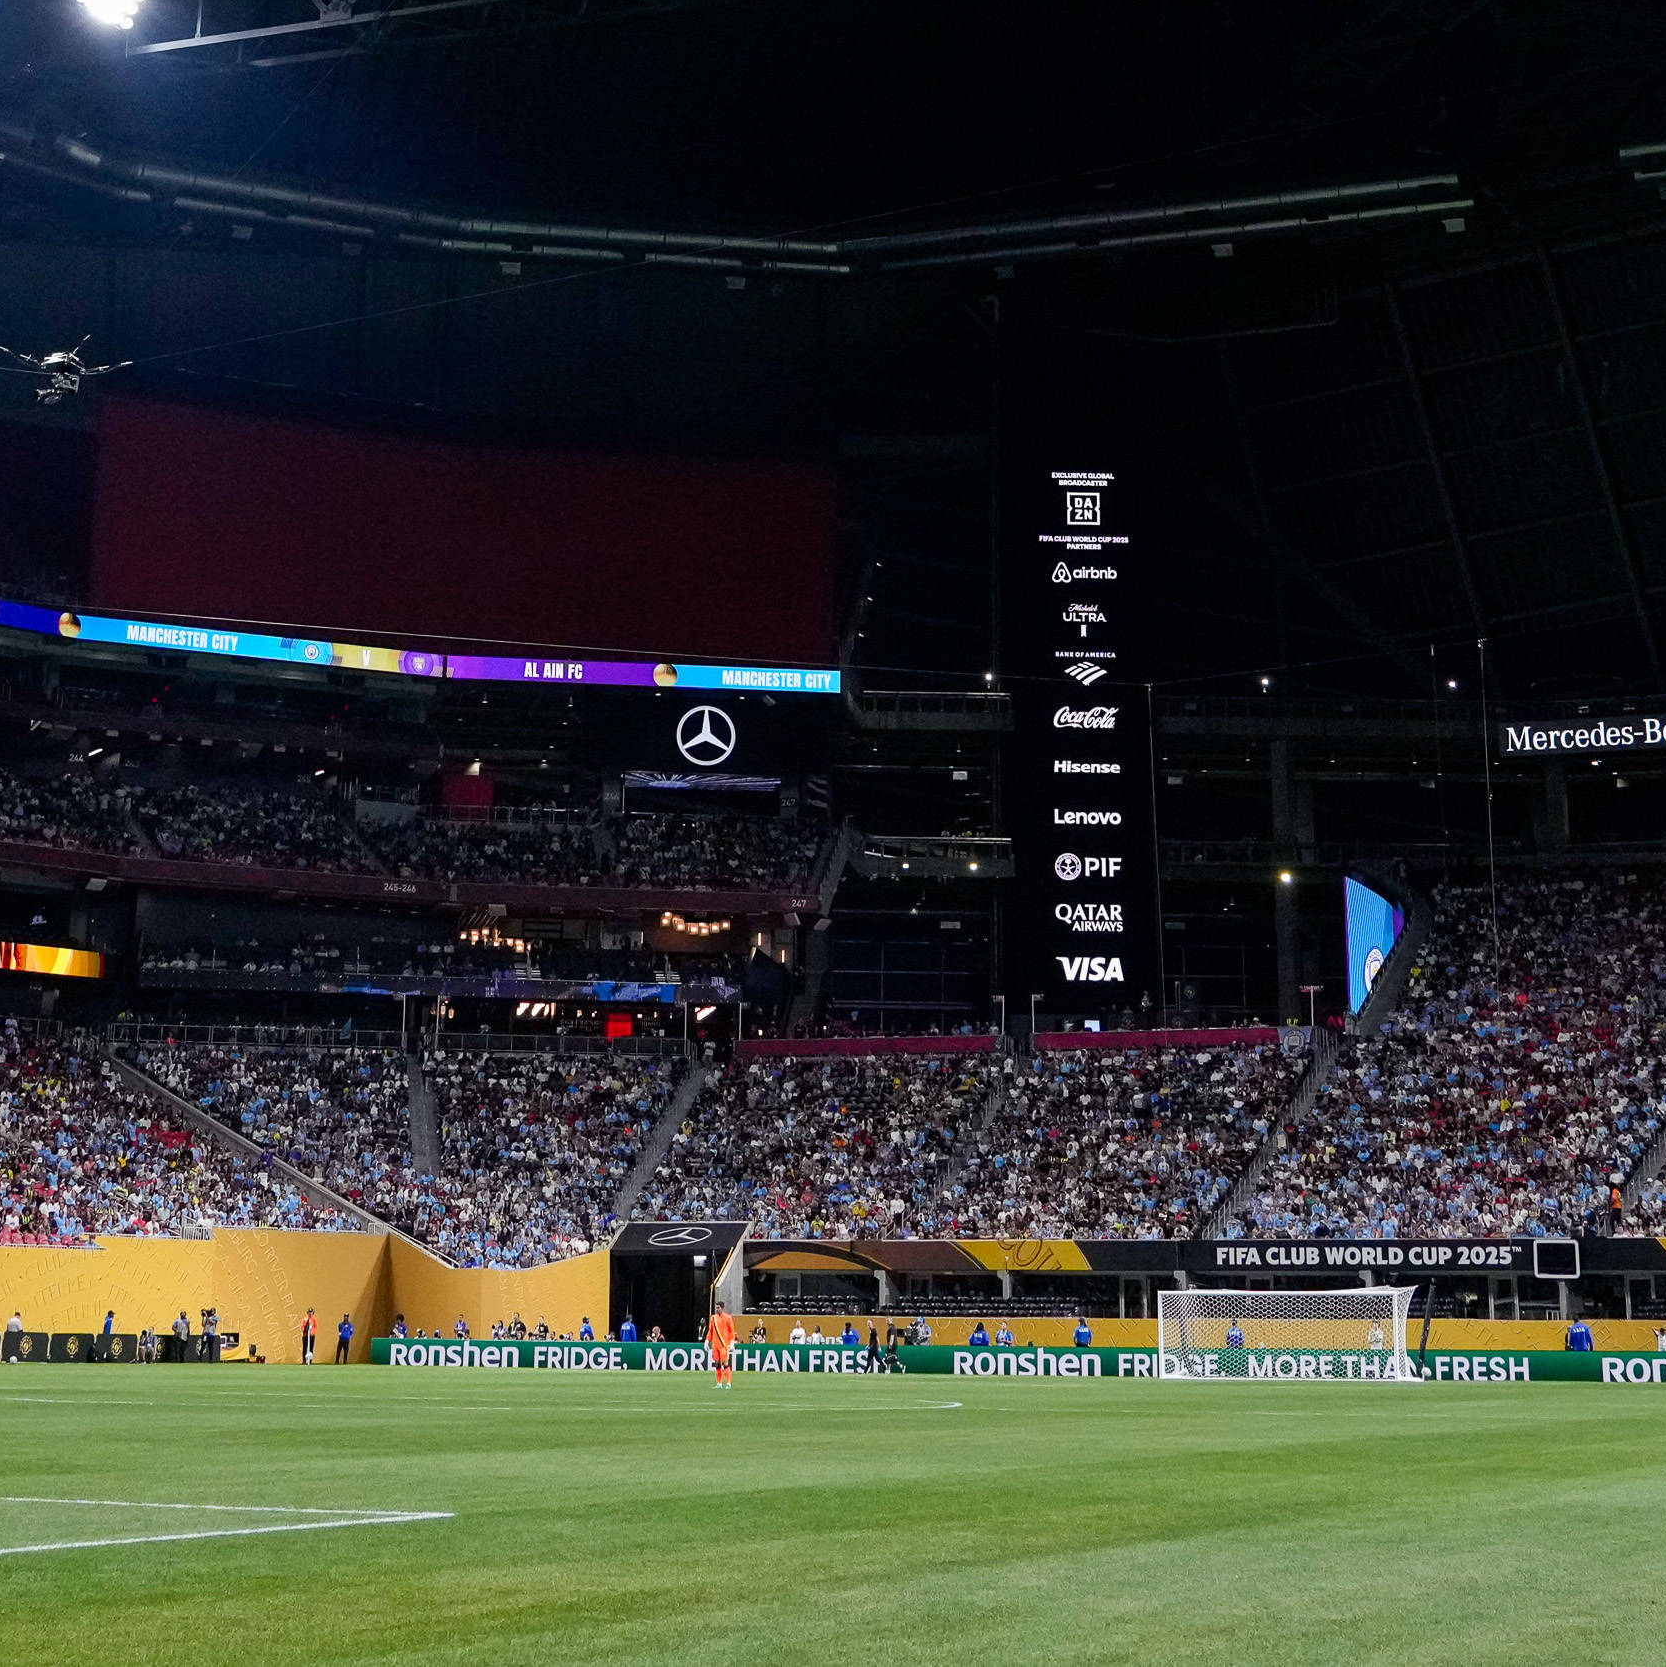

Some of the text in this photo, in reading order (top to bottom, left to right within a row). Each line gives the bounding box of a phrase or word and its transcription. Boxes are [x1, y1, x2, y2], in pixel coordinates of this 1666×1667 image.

[1072, 566, 1117, 580] airbnb
[1062, 612, 1107, 623] ULTRA
[126, 623, 209, 650] MANCHESTER
[211, 631, 239, 652] CITY
[523, 660, 541, 680] AL
[542, 660, 565, 681] AIN
[566, 662, 584, 682] FC
[721, 668, 803, 689] MANCHESTER
[805, 670, 833, 690] CITY
[1055, 651, 1074, 659] BANK
[1053, 760, 1121, 775] Hisense
[1053, 808, 1122, 826] Lenovo
[1084, 856, 1123, 878] PIF
[1054, 903, 1124, 924] QATAR
[1072, 920, 1124, 933] AIRWAYS
[1055, 956, 1126, 982] VISA
[1216, 1246, 1453, 1266] FIFA CLUB WORLD CUP
[389, 1340, 520, 1368] Ronshen
[729, 1348, 800, 1373] THAN
[953, 1347, 1102, 1377] Ronshen
[1247, 1354, 1335, 1379] MORE
[1436, 1355, 1531, 1382] FRESH
